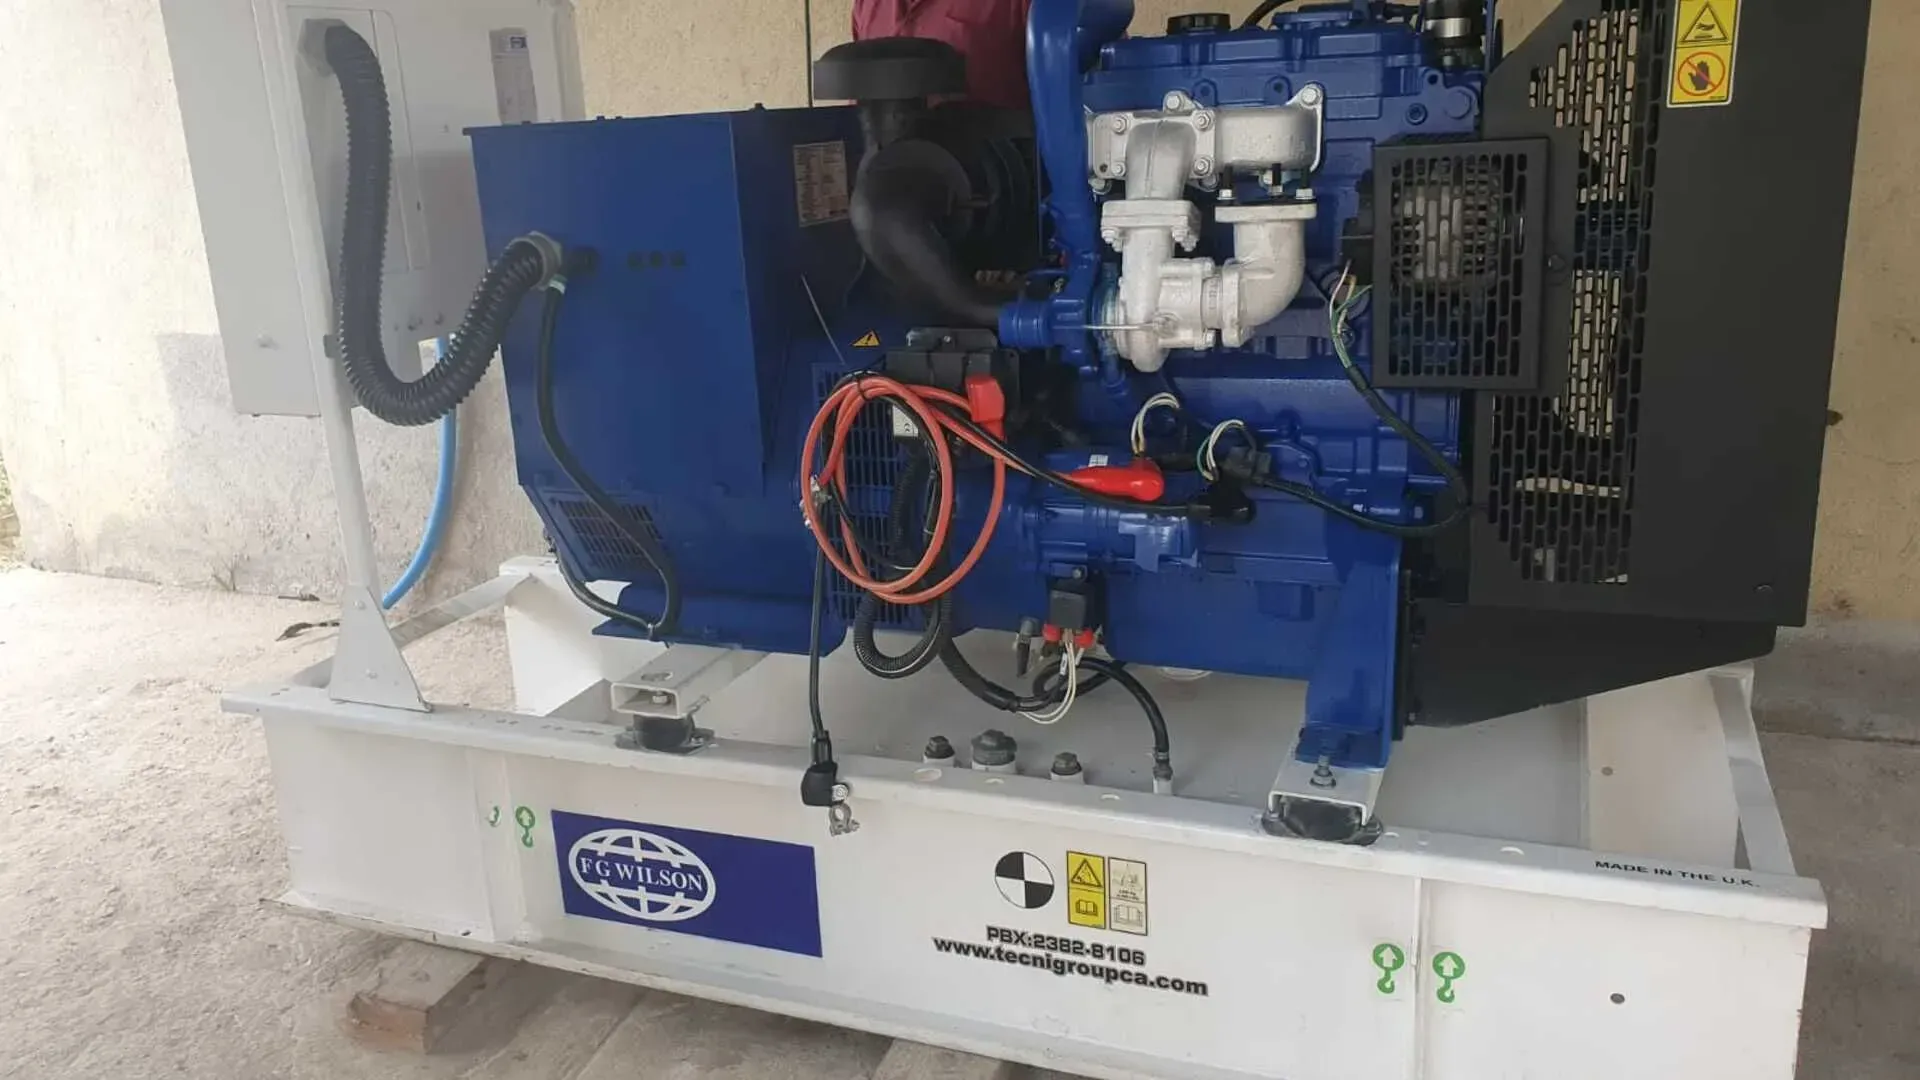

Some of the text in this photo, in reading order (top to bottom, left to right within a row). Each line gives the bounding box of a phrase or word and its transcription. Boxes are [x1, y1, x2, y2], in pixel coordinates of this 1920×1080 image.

[614, 863, 704, 892] WILSON
[1595, 861, 1761, 888] MADE IN THE U.K.
[931, 937, 1208, 996] www.tecnigroupca.com
